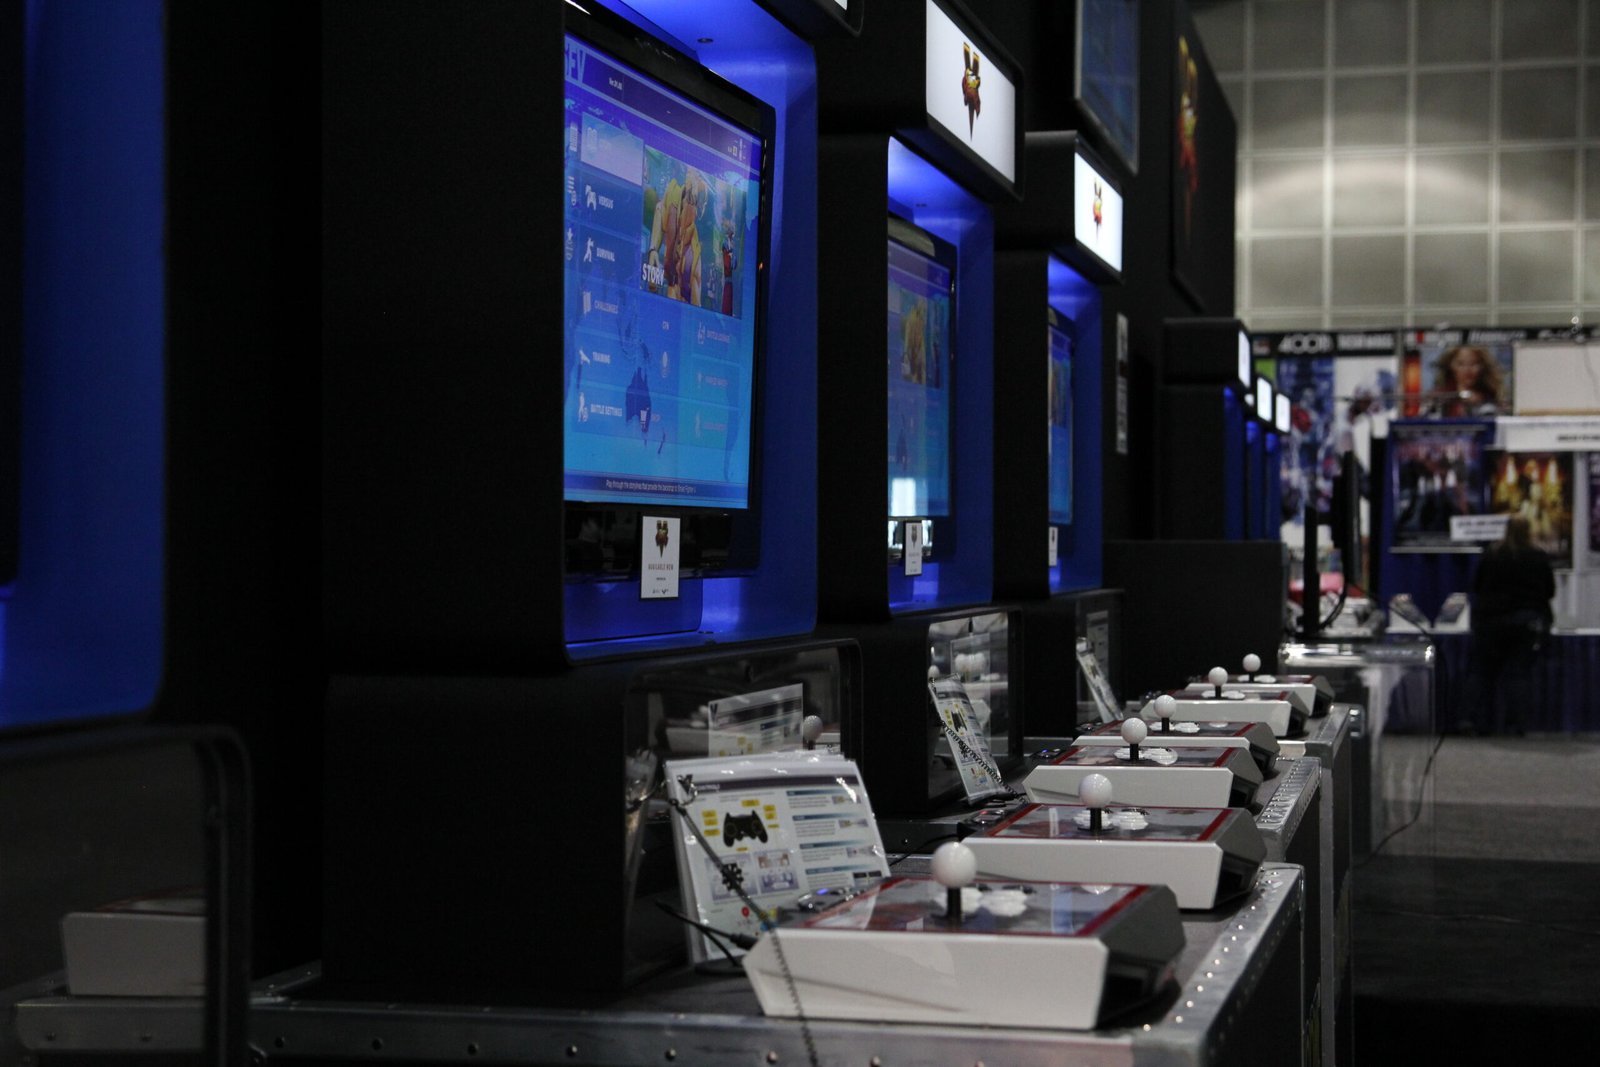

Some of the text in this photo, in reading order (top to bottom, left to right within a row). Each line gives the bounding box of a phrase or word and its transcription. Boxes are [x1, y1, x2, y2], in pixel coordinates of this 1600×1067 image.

[596, 248, 615, 262] SURVIVAL
[642, 264, 665, 286] STORY
[592, 352, 610, 364] TRAINING
[591, 404, 622, 417] BATTLE SETTINGS
